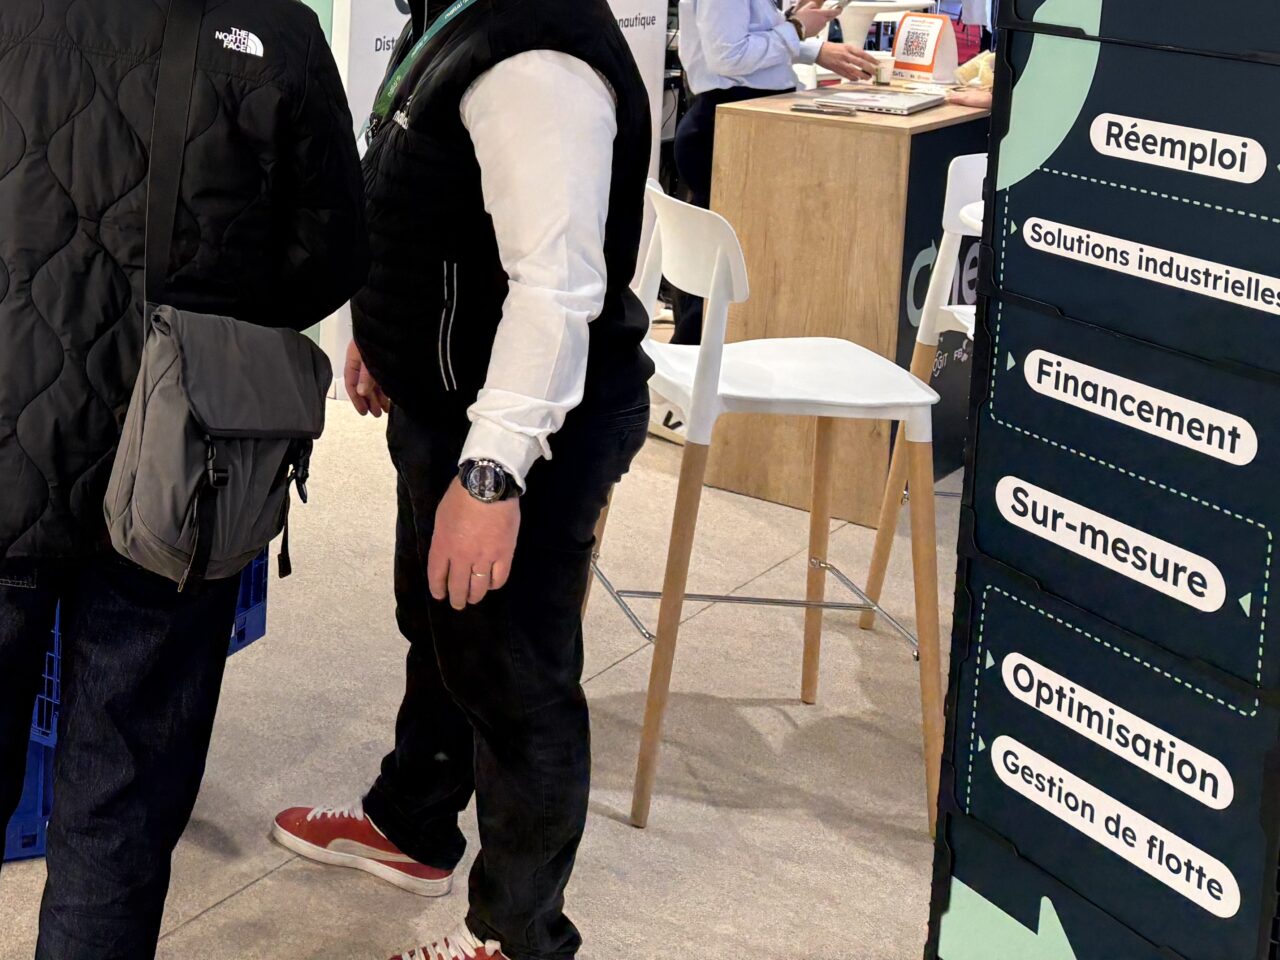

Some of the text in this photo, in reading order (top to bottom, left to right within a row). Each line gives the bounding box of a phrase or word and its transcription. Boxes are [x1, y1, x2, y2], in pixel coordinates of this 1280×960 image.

[215, 30, 248, 46] NORTH
[223, 41, 247, 53] FACE
[231, 27, 249, 38] THE
[375, 35, 397, 52] Dist
[1105, 120, 1248, 173] Réemploi
[1030, 222, 1130, 267] Solutions
[1036, 358, 1241, 454] Financement
[1010, 486, 1208, 598] Sur-mesure
[1012, 662, 1220, 799] Optimisation
[1002, 749, 1224, 901] Gestion de flotte
